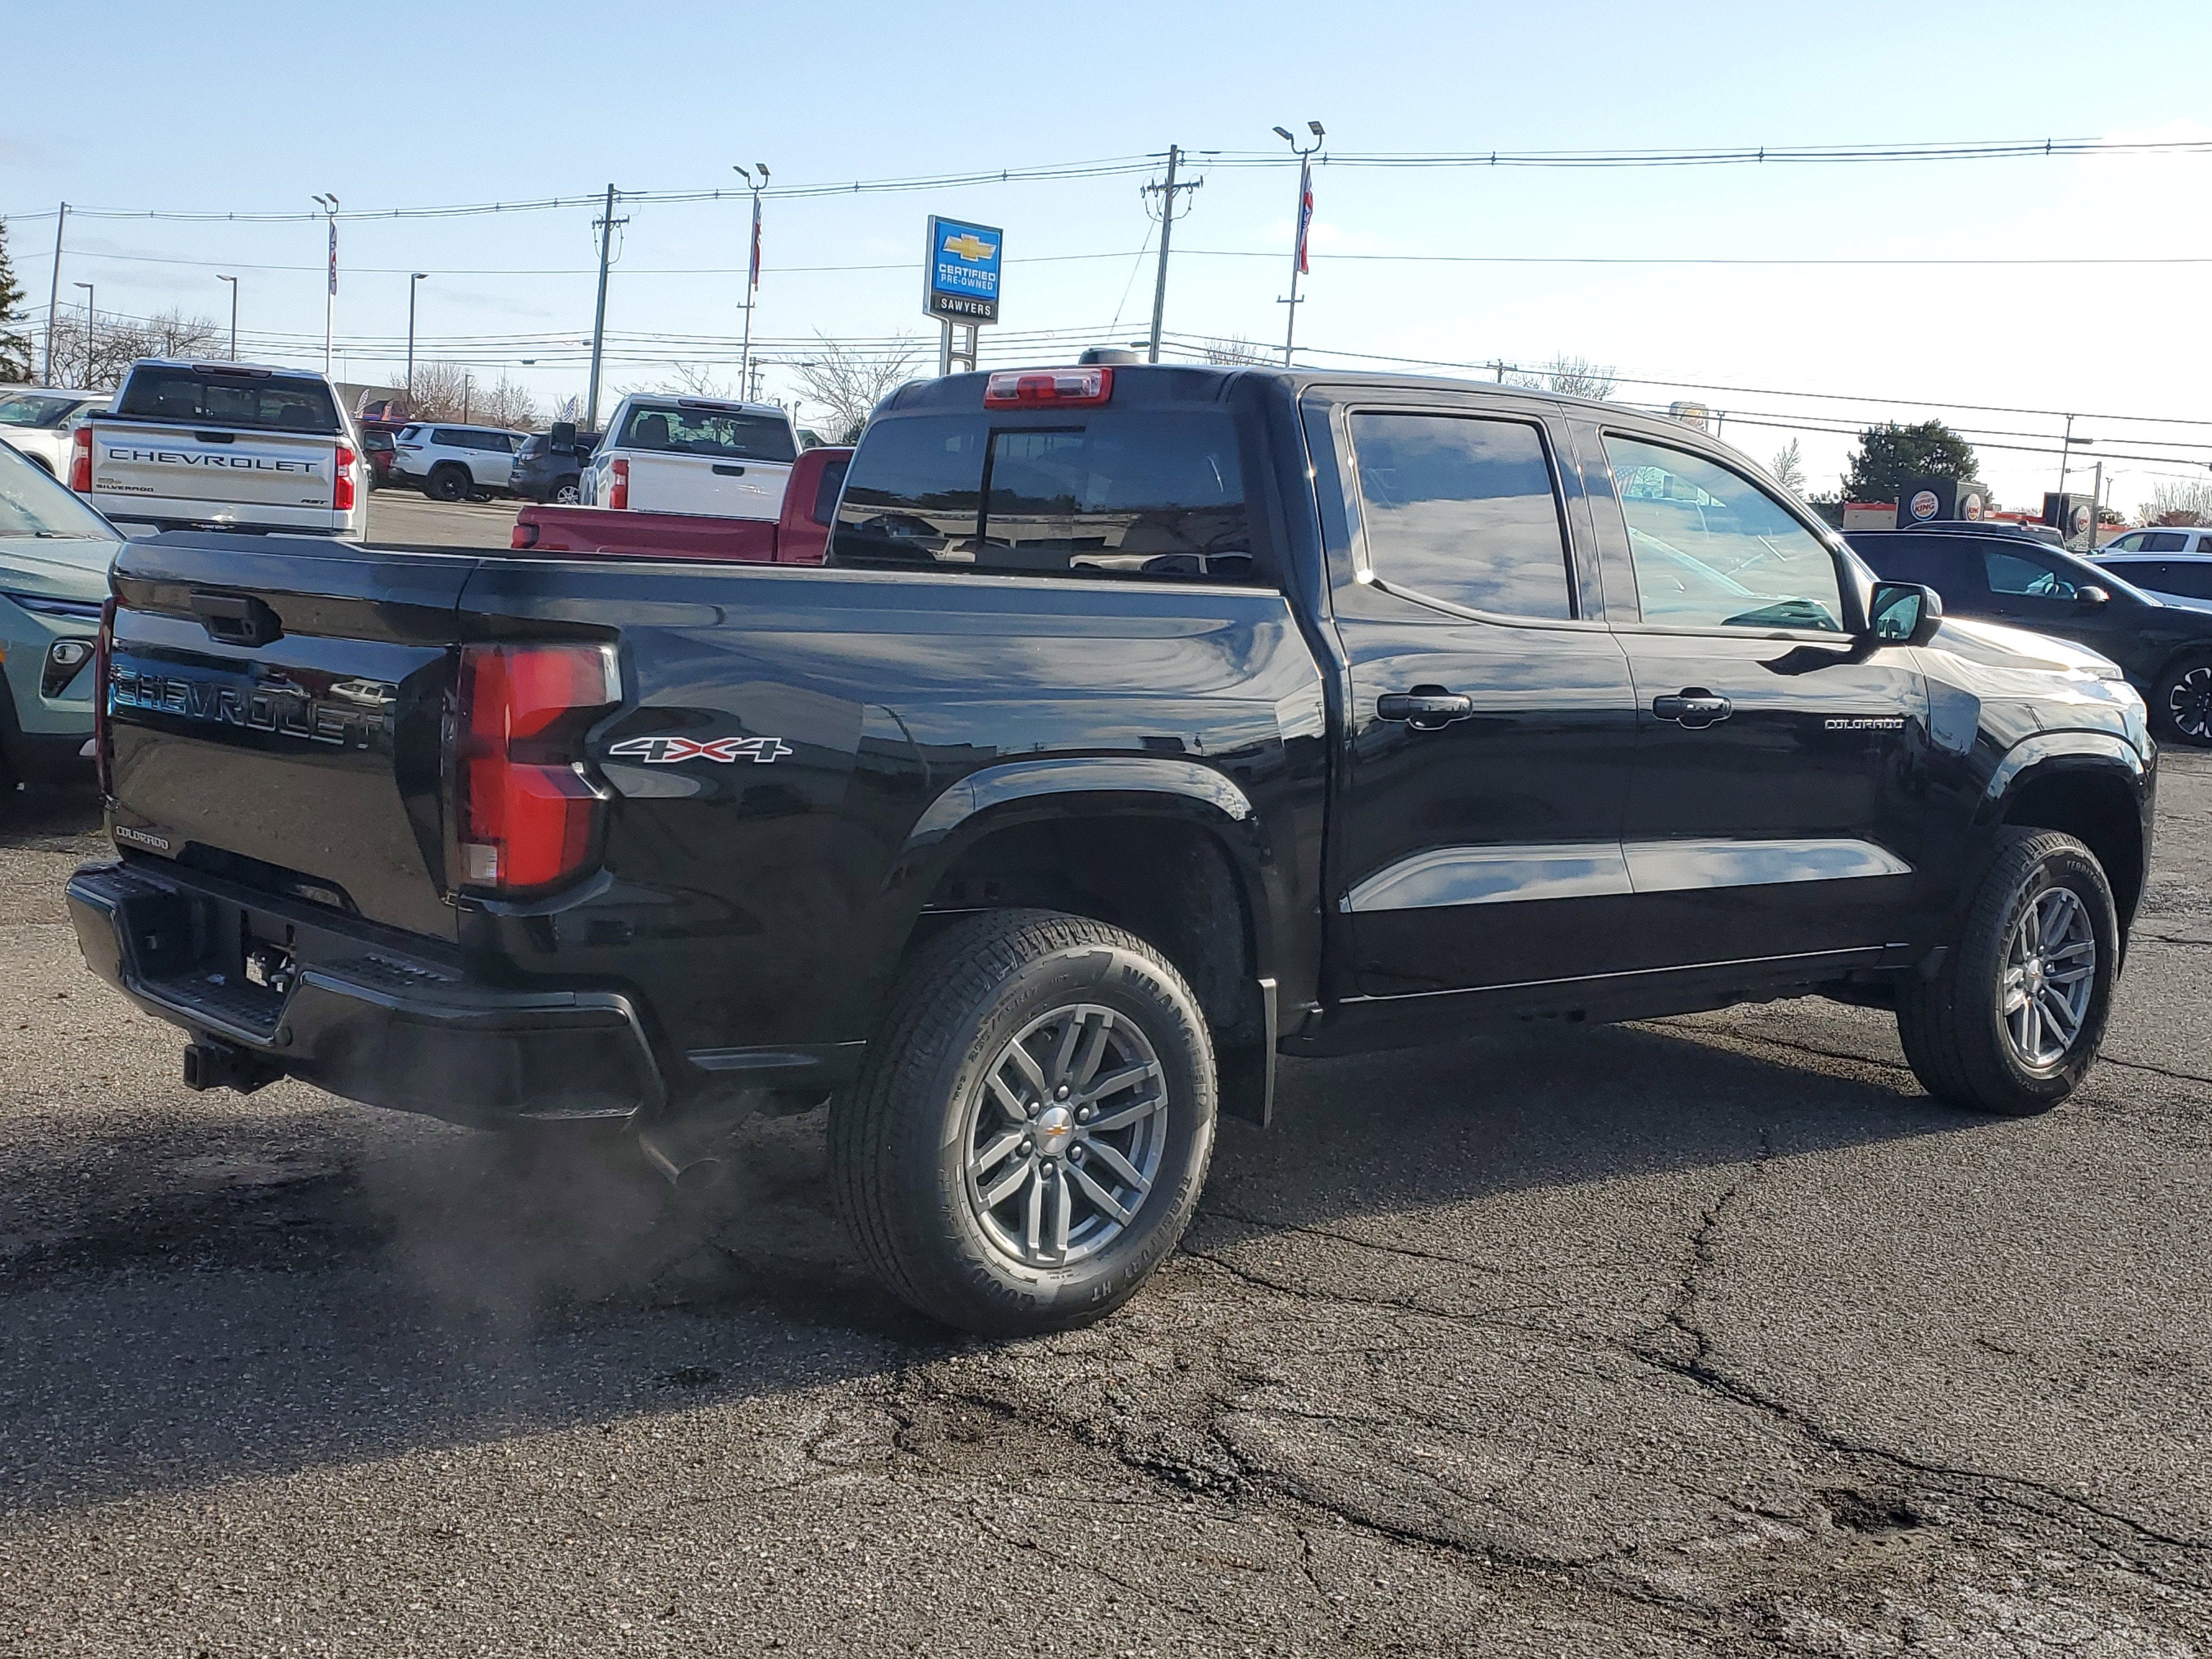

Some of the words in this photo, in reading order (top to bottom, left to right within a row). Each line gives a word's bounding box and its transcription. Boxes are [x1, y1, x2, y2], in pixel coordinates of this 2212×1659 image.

[939, 263, 996, 282] CERTIFIED
[940, 273, 993, 290] PRE-OWNED
[941, 298, 991, 316] SAWYERS
[109, 449, 318, 473] CHEVROLET
[1915, 503, 1935, 512] KING
[112, 666, 384, 749] CHEVROLET
[1825, 718, 1904, 730] COLORADO
[116, 826, 169, 850] COLORADO
[1122, 964, 1207, 1106] WRANGLER
[1091, 1280, 1112, 1302] HT
